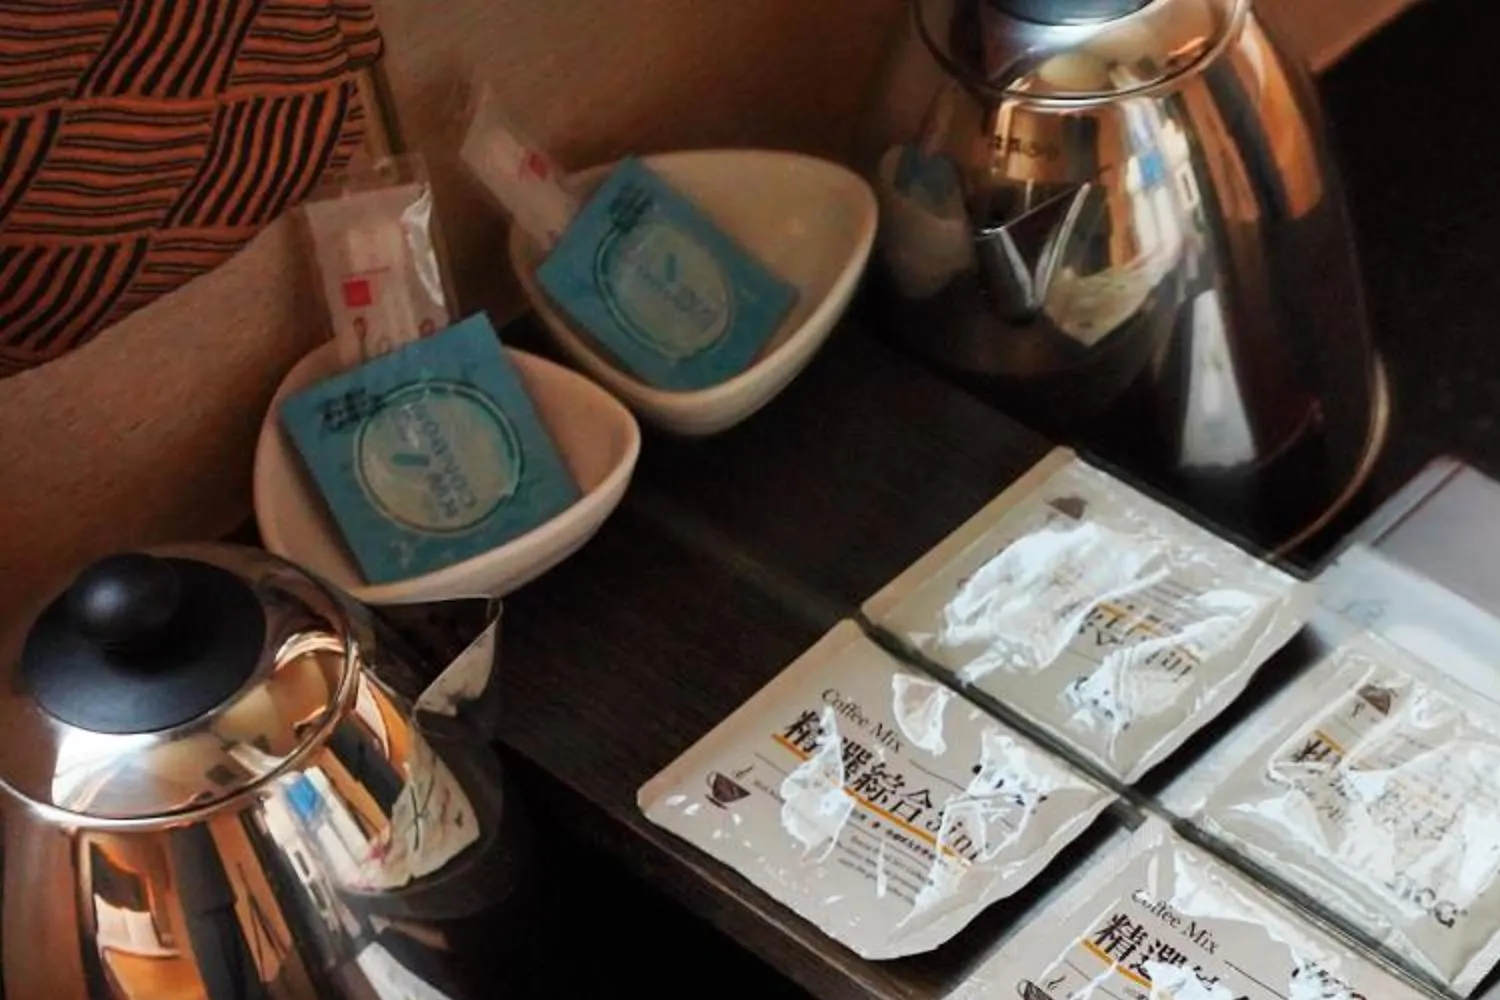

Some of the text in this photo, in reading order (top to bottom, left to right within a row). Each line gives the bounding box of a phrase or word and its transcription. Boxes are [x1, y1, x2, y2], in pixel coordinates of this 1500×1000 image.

[821, 687, 902, 755] Coffee Mix
[1131, 889, 1221, 955] Coffee Mix
